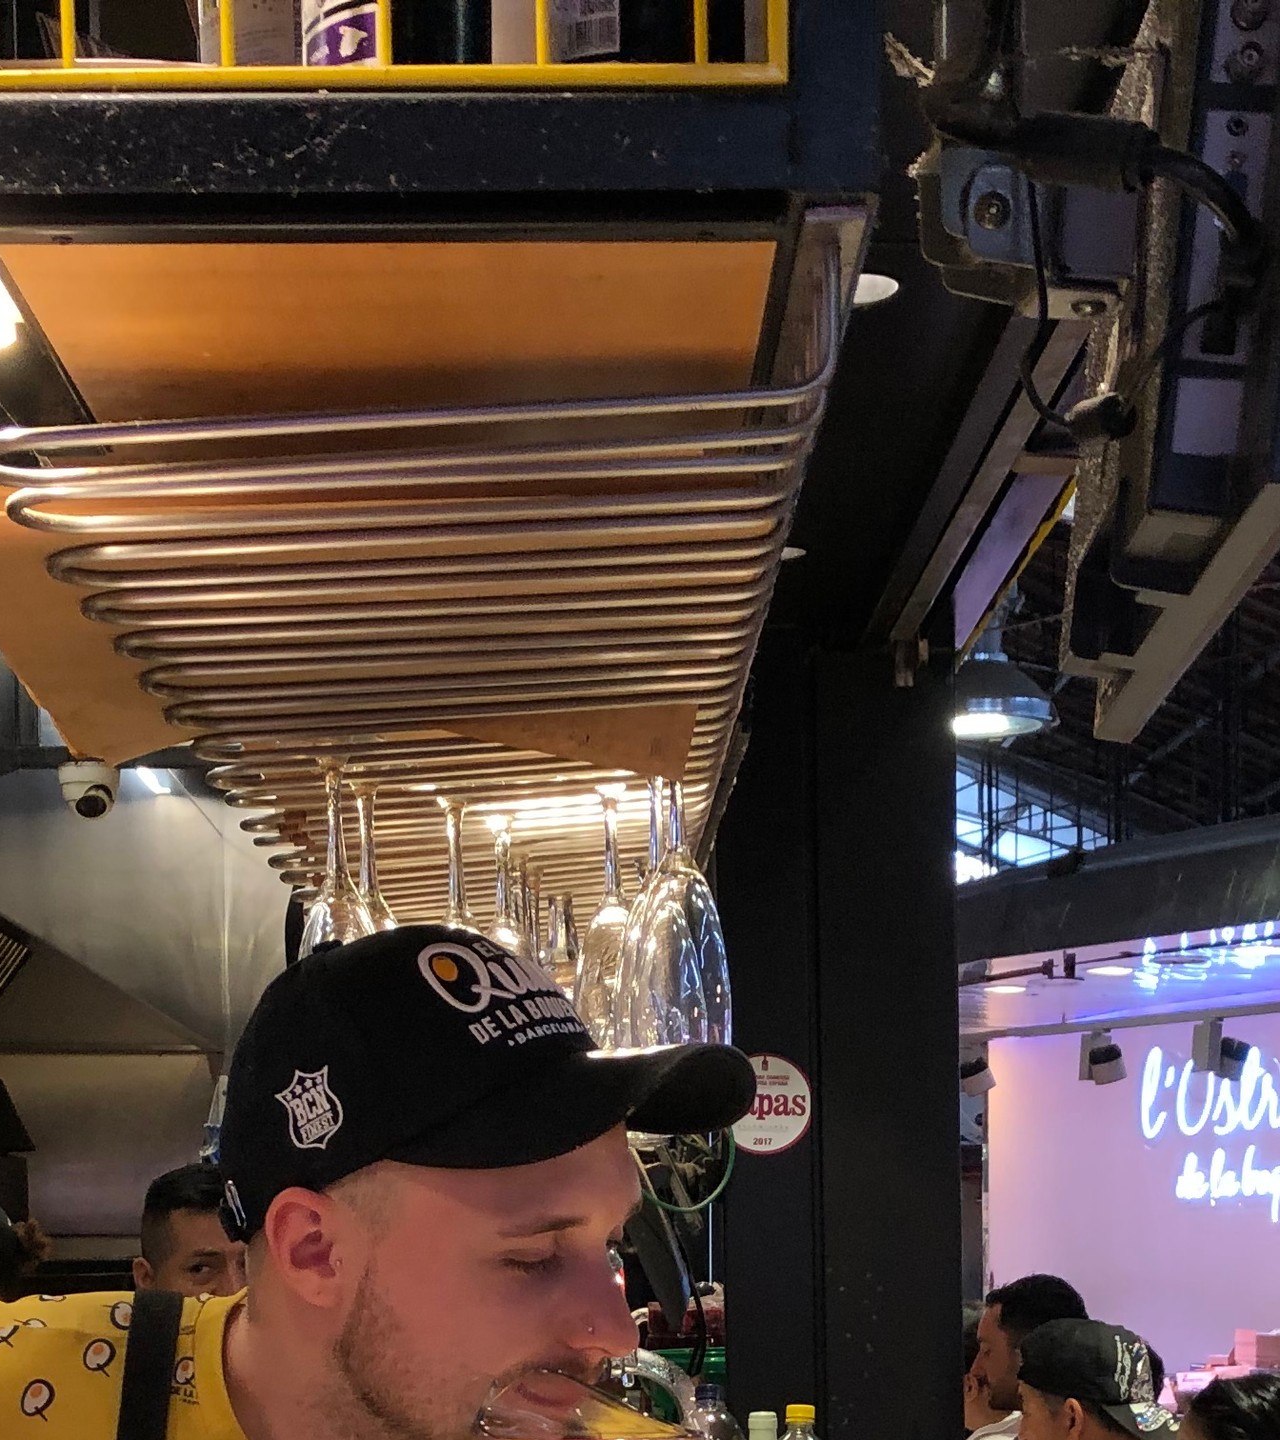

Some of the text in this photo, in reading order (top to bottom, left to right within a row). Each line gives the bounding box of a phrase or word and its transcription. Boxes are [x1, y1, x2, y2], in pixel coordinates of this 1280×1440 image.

[468, 1016, 503, 1045] DE
[495, 1005, 529, 1030] LA
[290, 1085, 331, 1128] BCN
[748, 1093, 806, 1120] pas
[753, 1137, 773, 1146] 2017
